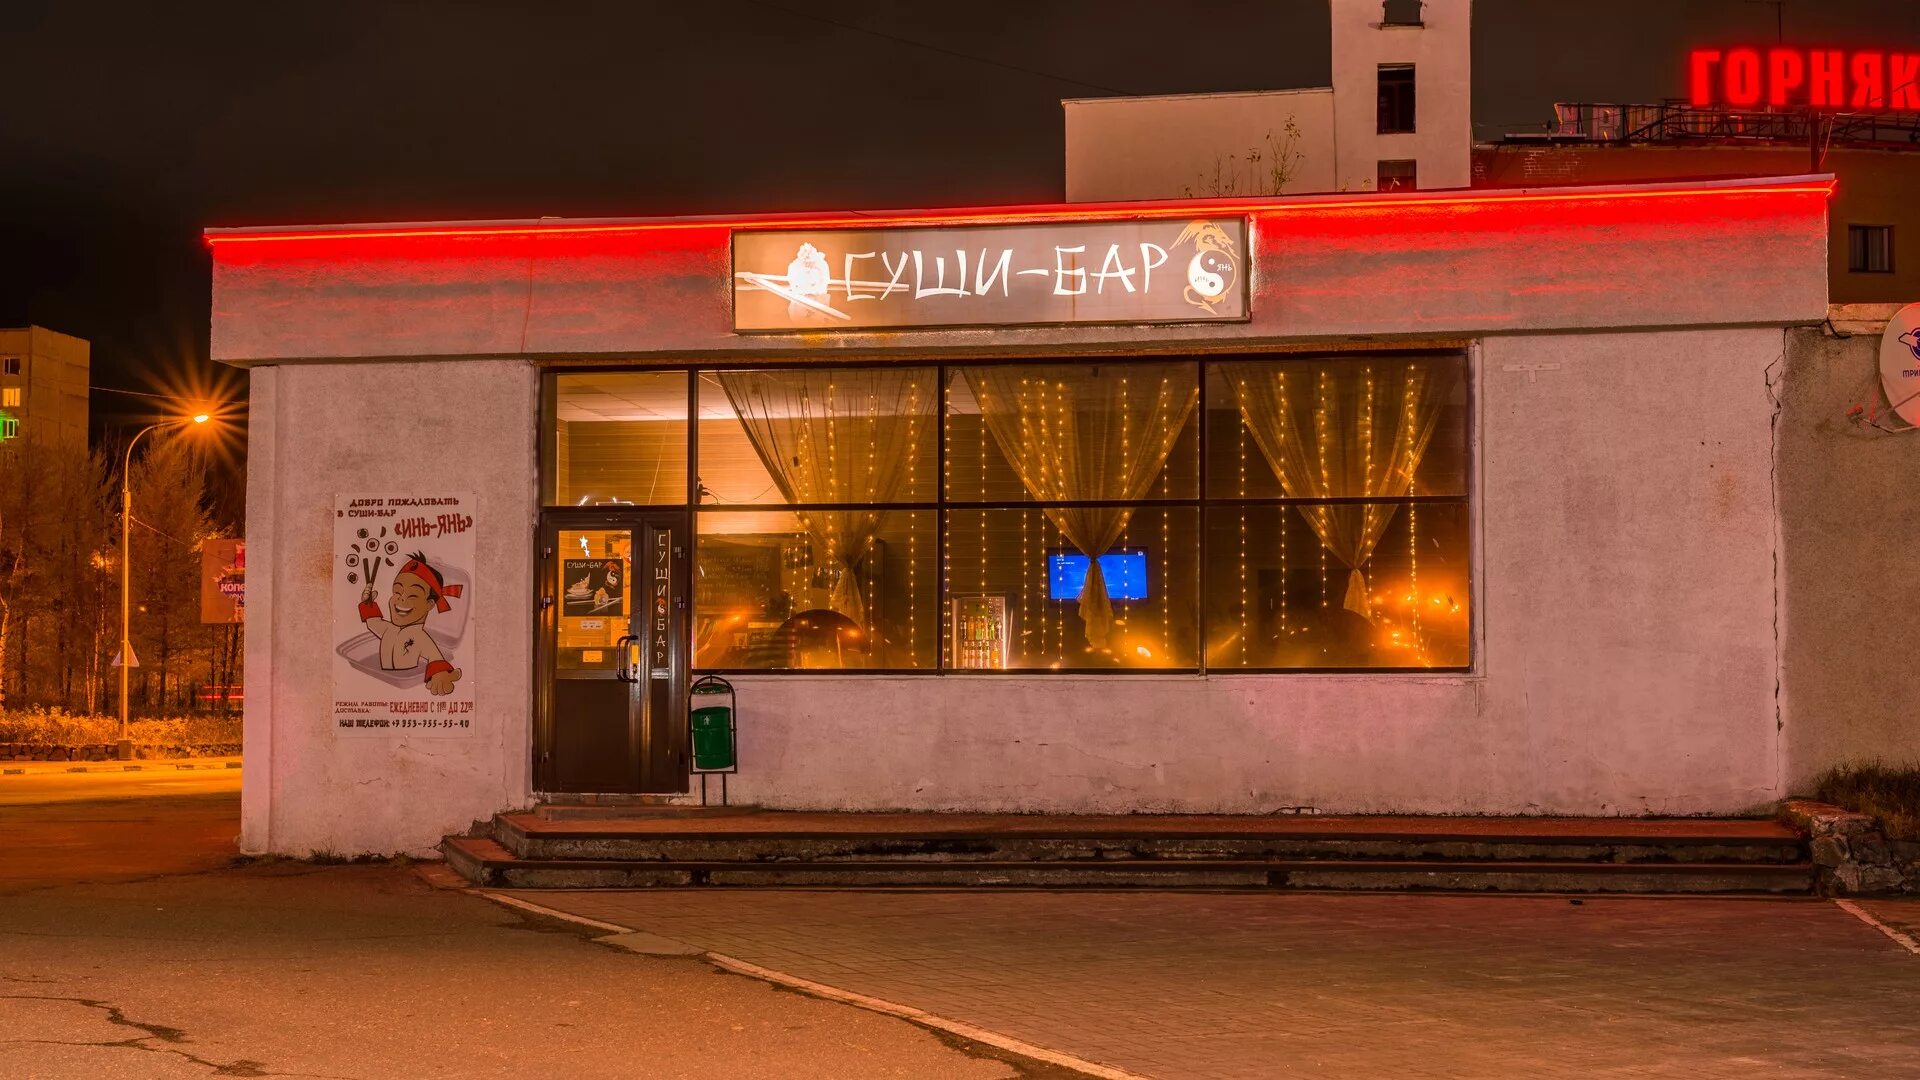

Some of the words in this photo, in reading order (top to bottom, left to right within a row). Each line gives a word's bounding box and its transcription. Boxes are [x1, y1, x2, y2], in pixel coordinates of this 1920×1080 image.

[1691, 50, 1920, 109] ГОРНЯК
[845, 243, 1169, 301] СУШИ-БАР
[1216, 263, 1233, 272] ЯНЬ
[1902, 369, 1920, 378] ТРИ
[349, 499, 384, 508] ДОБРО
[387, 497, 460, 507] ПОЖАЛОВАТЬ
[337, 510, 344, 518] В
[348, 509, 397, 518] СУШИ-БАР
[394, 513, 474, 539] «ИНЬ-ЯНЬ»
[448, 701, 458, 715] ДО
